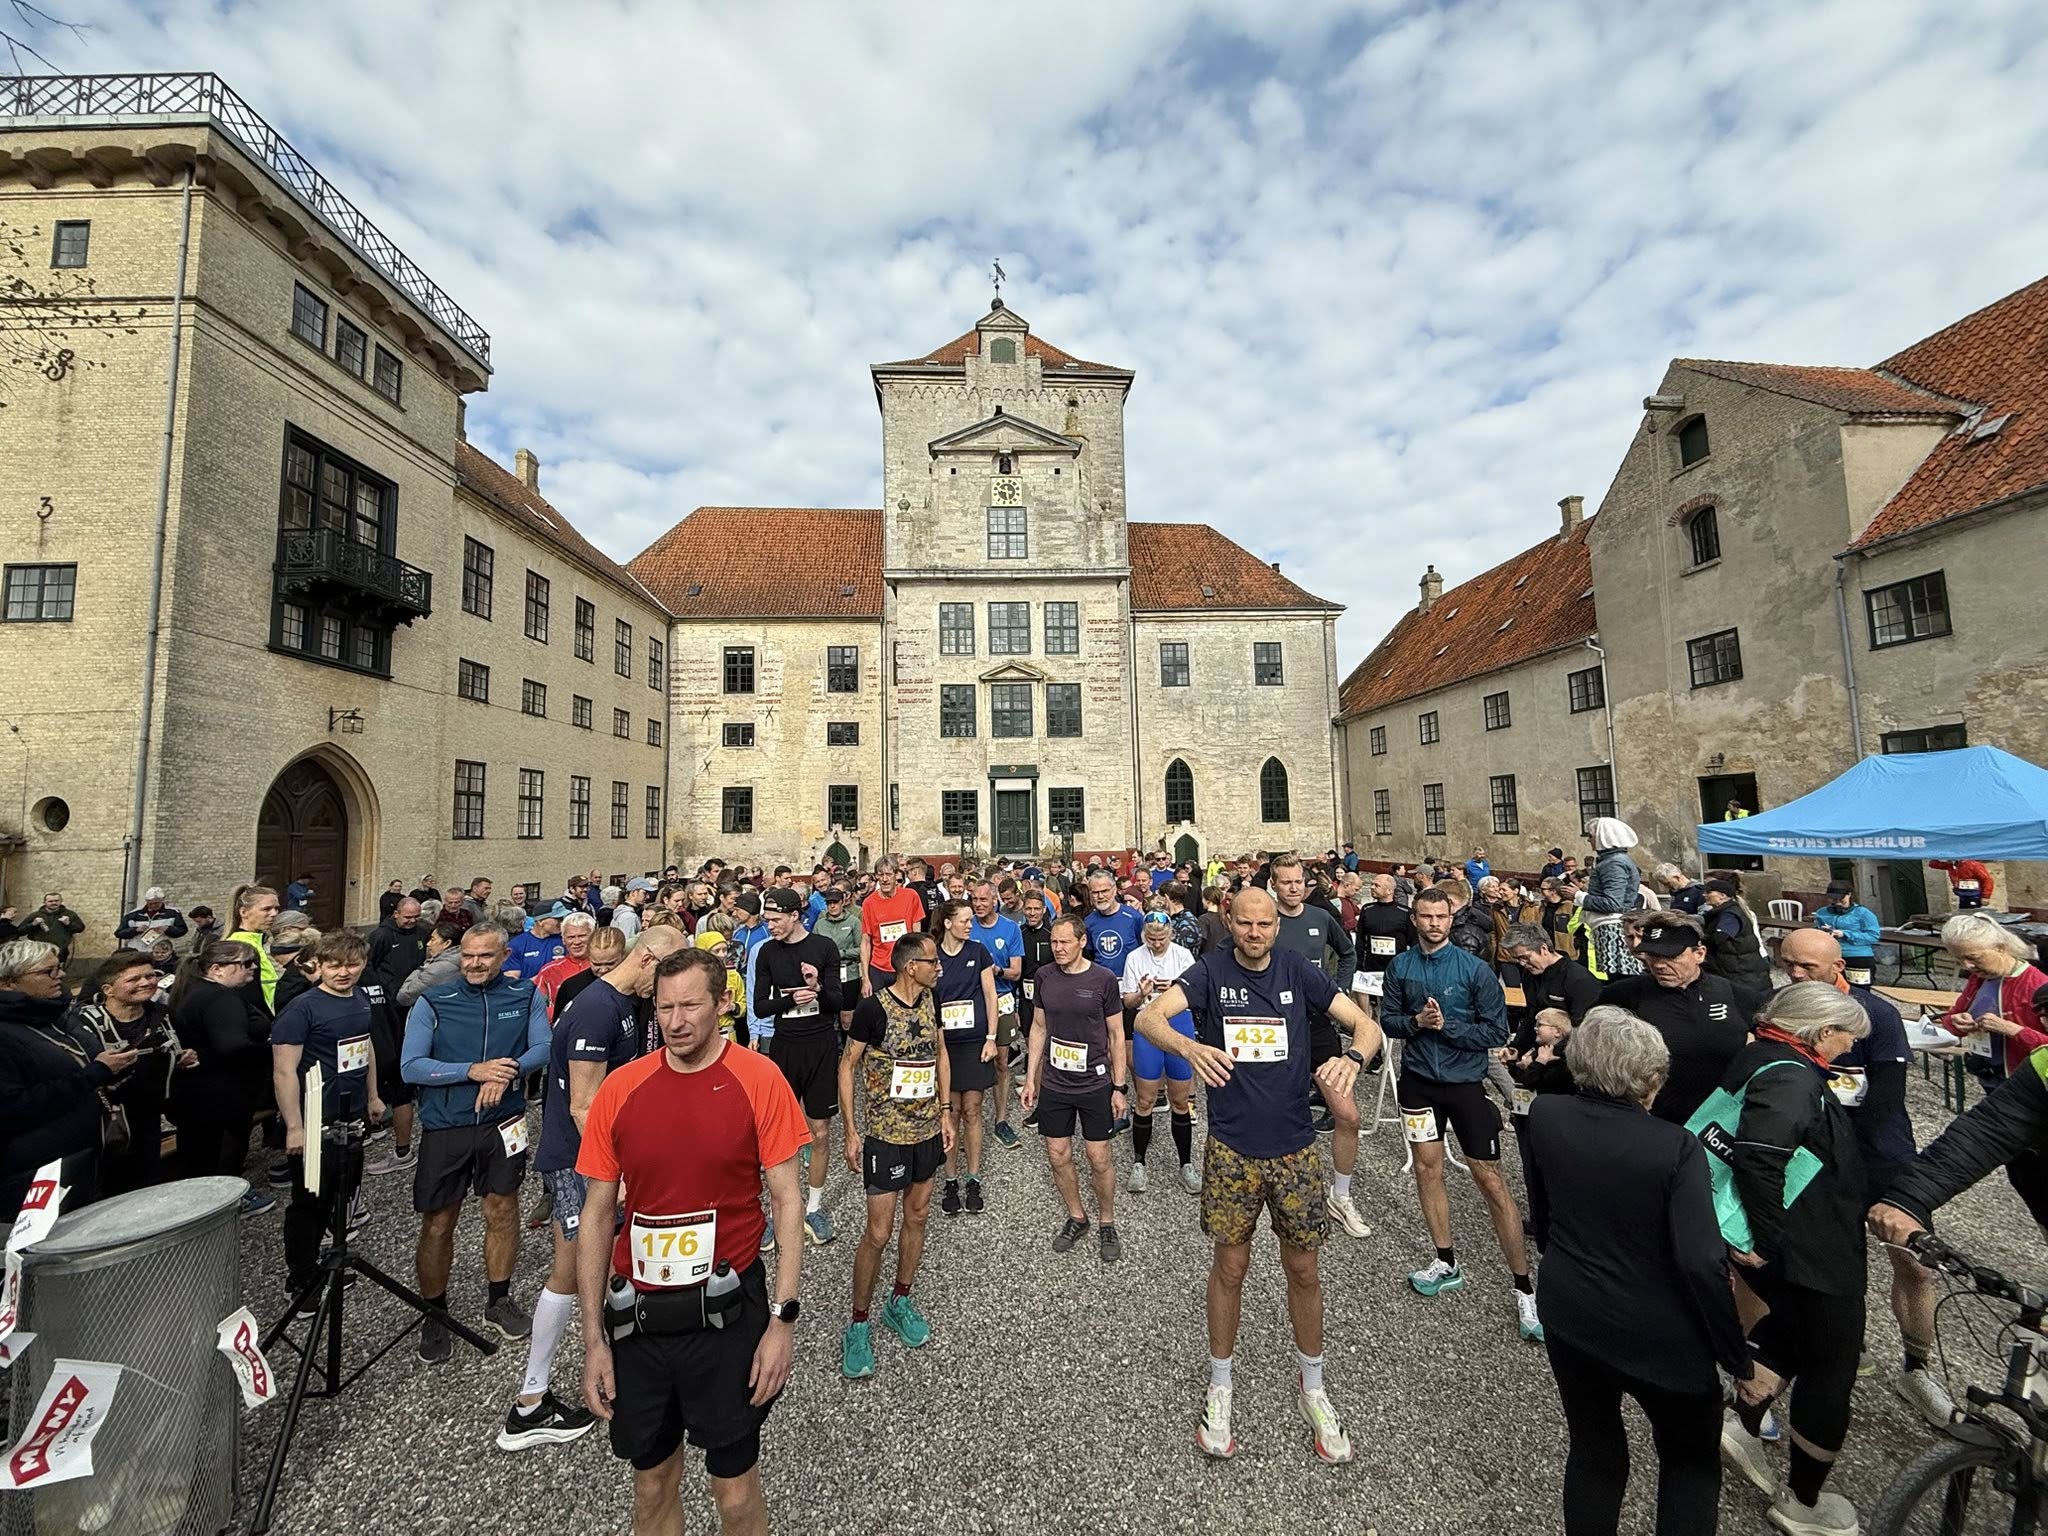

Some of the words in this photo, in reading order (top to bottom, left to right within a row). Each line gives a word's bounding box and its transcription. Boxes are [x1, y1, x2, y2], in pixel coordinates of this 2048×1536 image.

[1768, 837, 1827, 848] STEVNS
[884, 925, 903, 935] 325
[943, 1007, 968, 1019] 007
[1235, 1028, 1277, 1044] 432
[1055, 1046, 1080, 1061] 006
[900, 1070, 931, 1084] 299
[642, 1230, 699, 1257] 176
[236, 1330, 266, 1391] MENY
[19, 1387, 77, 1474] MENY
